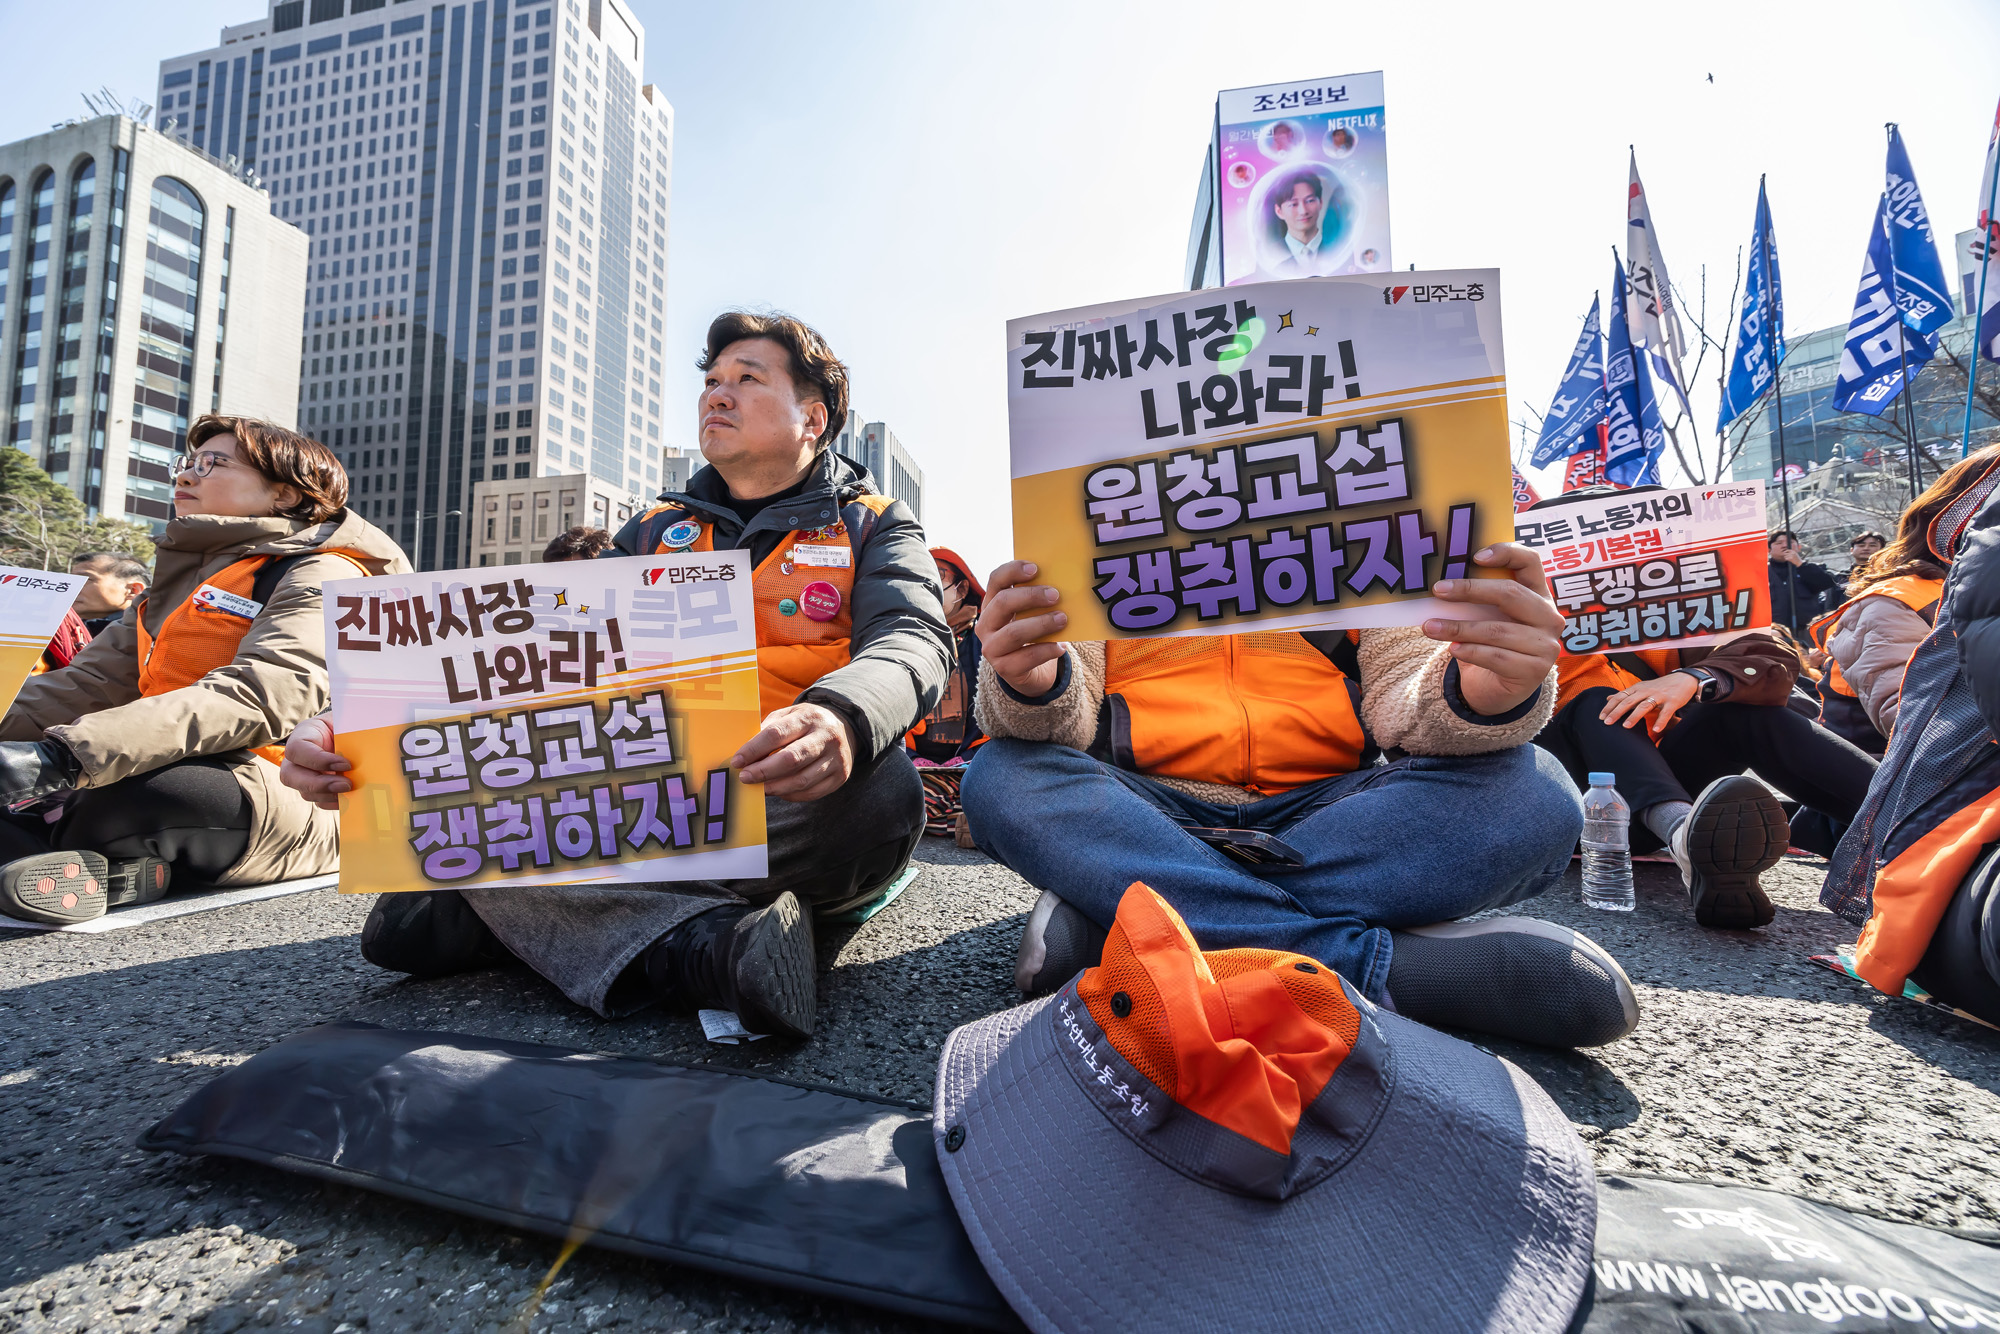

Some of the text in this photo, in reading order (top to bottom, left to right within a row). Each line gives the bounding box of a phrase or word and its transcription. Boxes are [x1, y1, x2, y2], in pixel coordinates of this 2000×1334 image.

[1252, 85, 1350, 113] 조선일보
[1327, 113, 1378, 132] NETFLIX
[1412, 281, 1485, 303] 민주노총
[1020, 299, 1258, 389] 진짜사장
[1140, 339, 1362, 440] 나와라!
[1083, 417, 1411, 547] 원청교섭
[1717, 487, 1756, 500] 민주노총
[1514, 493, 1693, 548] 모든 노동자의
[16, 575, 71, 593] 민주노총
[669, 563, 736, 584] 민주노총
[1092, 502, 1477, 632] 쟁취하자!
[1552, 550, 1726, 612] 투쟁으로
[335, 578, 535, 652] 진짜사장
[1560, 588, 1753, 655] 쟁취하자!
[441, 616, 628, 704] 나와라!
[399, 689, 676, 800] 원청교섭
[408, 767, 730, 883] 쟁취하자!
[1595, 1259, 2000, 1331] www.jangtoo.co
